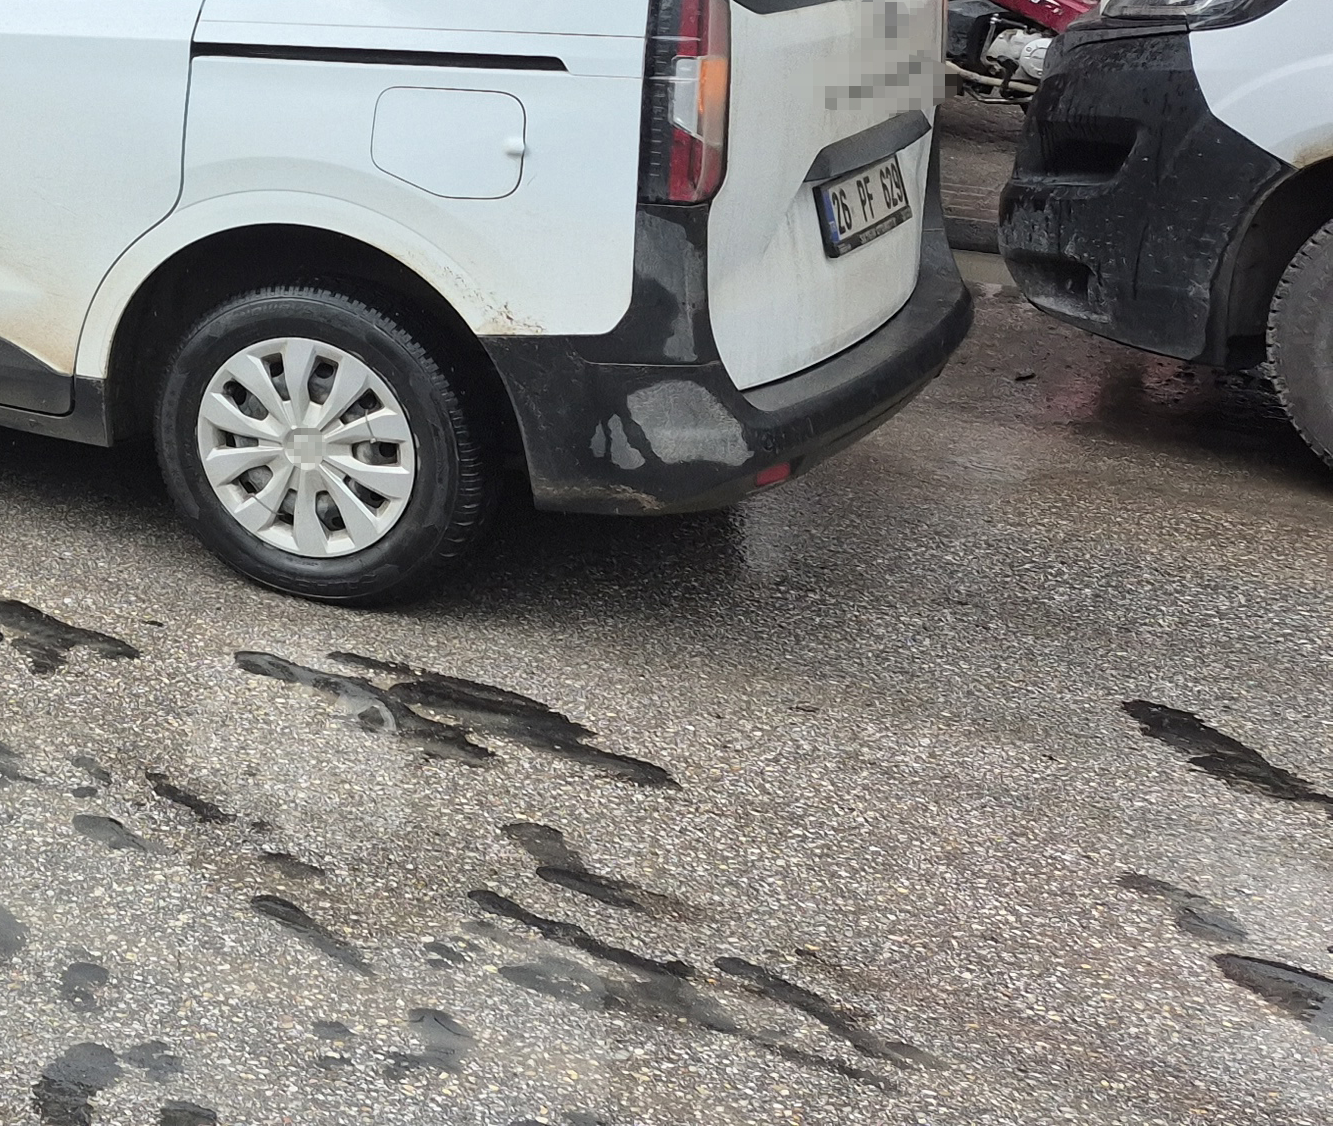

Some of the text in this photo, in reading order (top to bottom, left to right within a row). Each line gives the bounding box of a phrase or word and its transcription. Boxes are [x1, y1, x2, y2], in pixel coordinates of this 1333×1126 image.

[831, 188, 853, 235] 26
[855, 175, 875, 222] PF
[879, 162, 904, 210] 629
